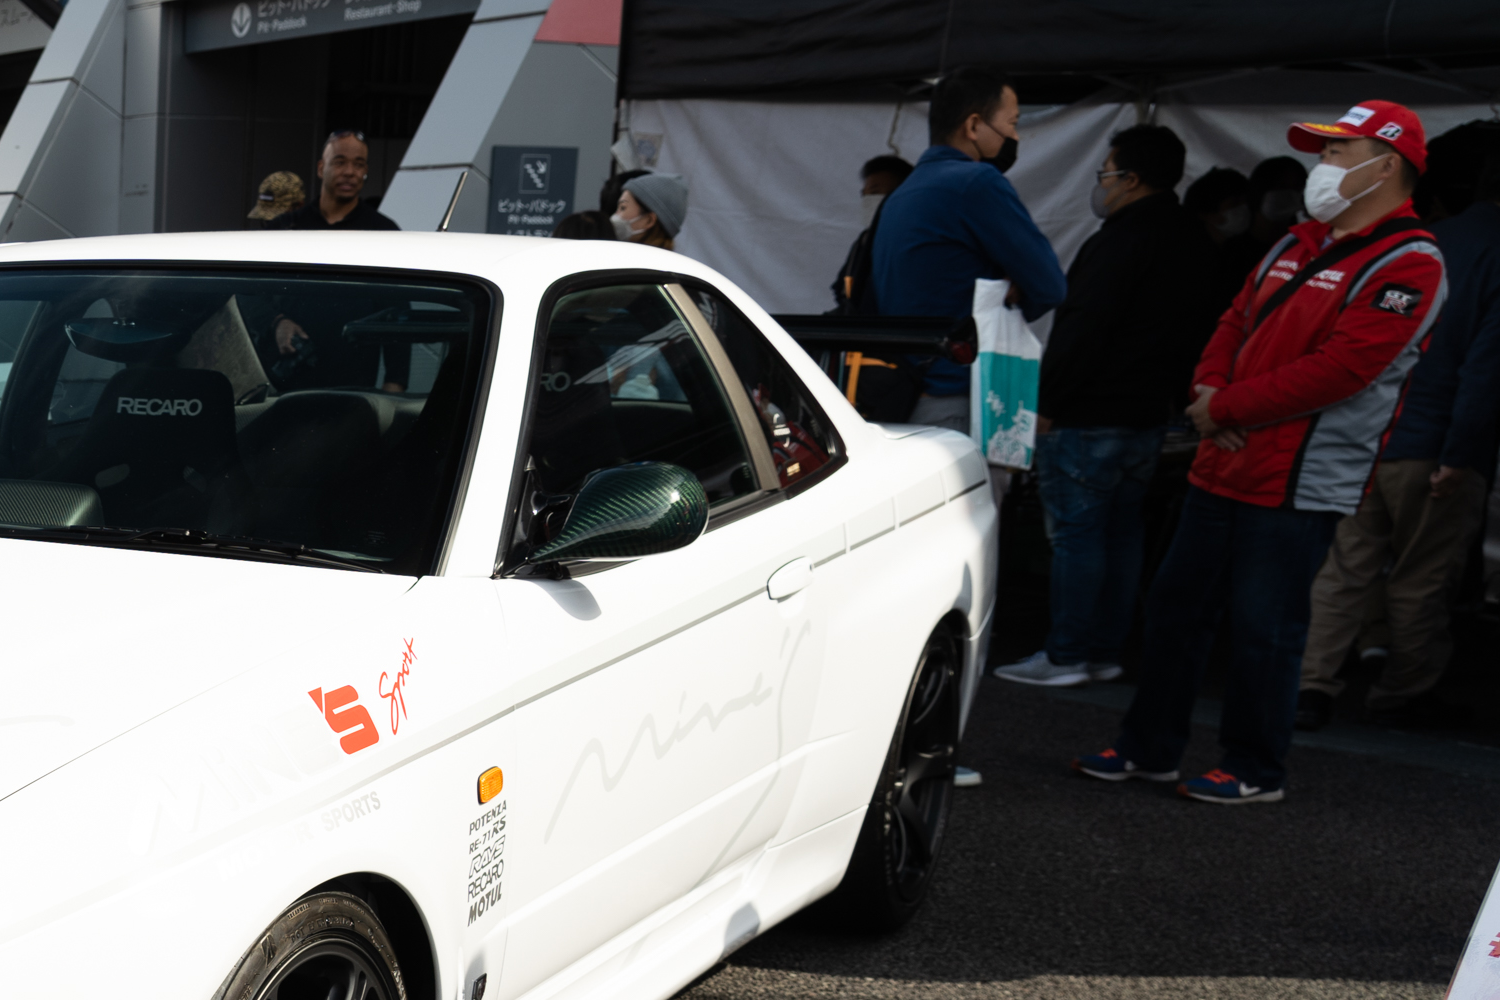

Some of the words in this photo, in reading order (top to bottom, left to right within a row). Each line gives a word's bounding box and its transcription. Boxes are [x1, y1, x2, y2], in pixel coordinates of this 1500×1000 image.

[116, 396, 203, 416] RECARO
[320, 789, 382, 833] SPORTS
[468, 799, 507, 836] POTENZA
[468, 834, 506, 880] RAYS
[467, 858, 504, 903] RECARO
[467, 881, 502, 928] MOTUL
